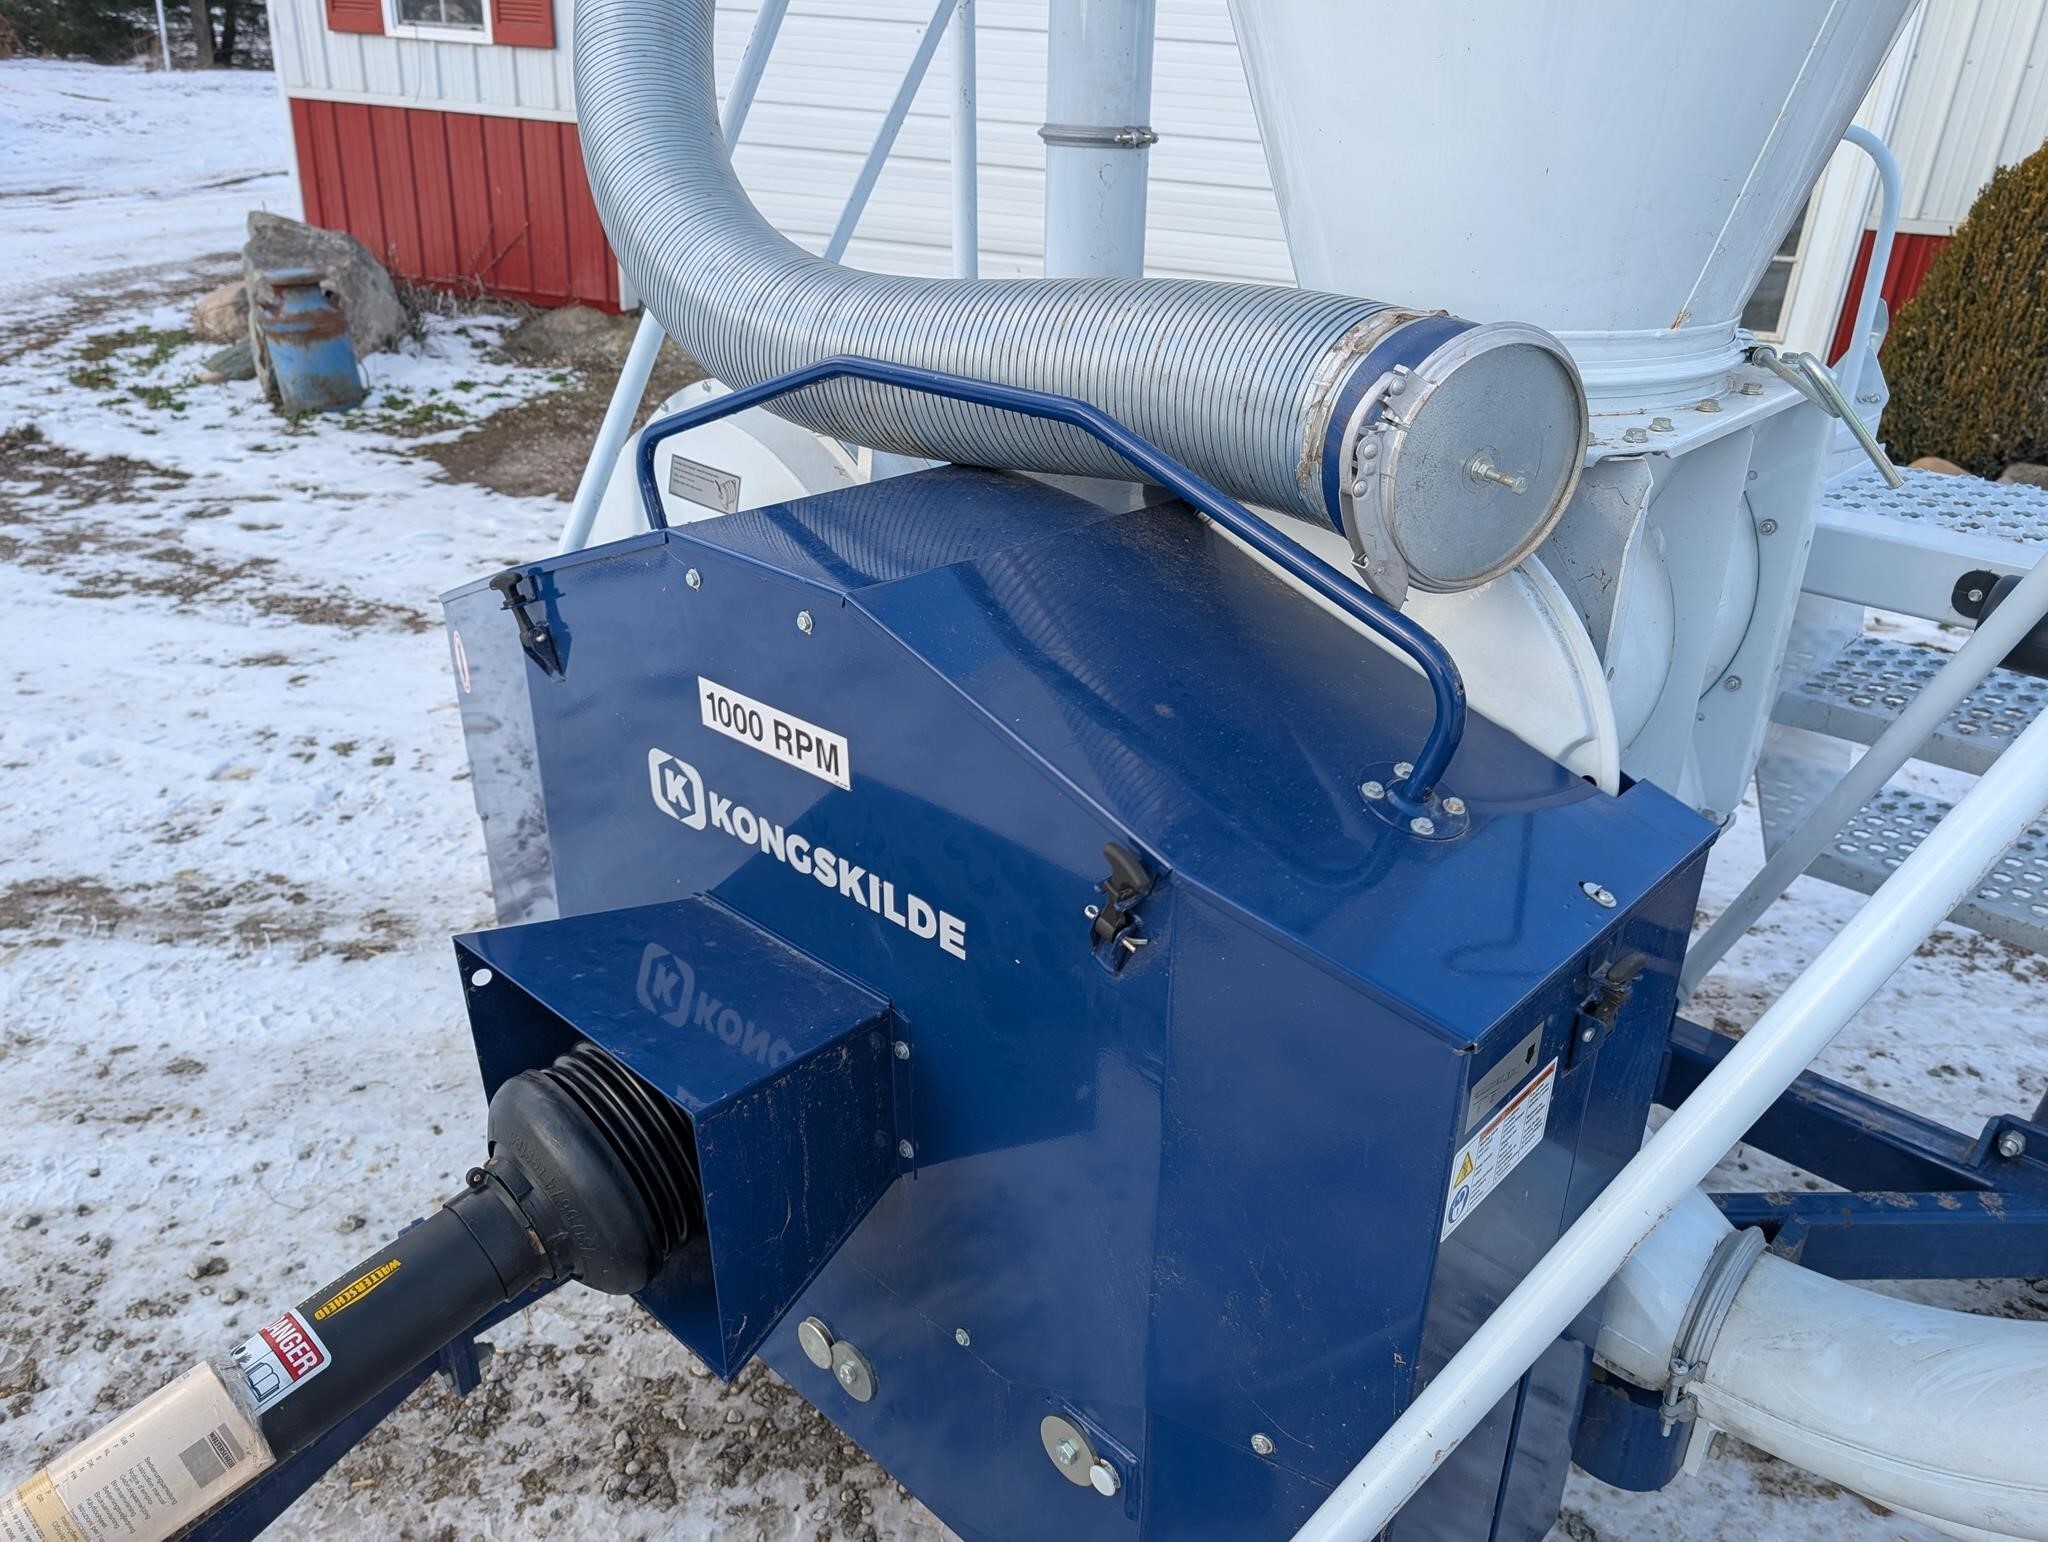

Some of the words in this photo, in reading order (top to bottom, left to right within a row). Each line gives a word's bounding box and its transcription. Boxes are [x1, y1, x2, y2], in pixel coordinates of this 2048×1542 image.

[706, 692, 763, 742] 1000
[773, 720, 840, 776] RPM
[664, 767, 692, 811] K
[709, 790, 967, 961] KONGSKILDE
[314, 1259, 402, 1321] WALTERSCHEID
[137, 1463, 154, 1488] Instruction
[152, 1487, 167, 1505] manual
